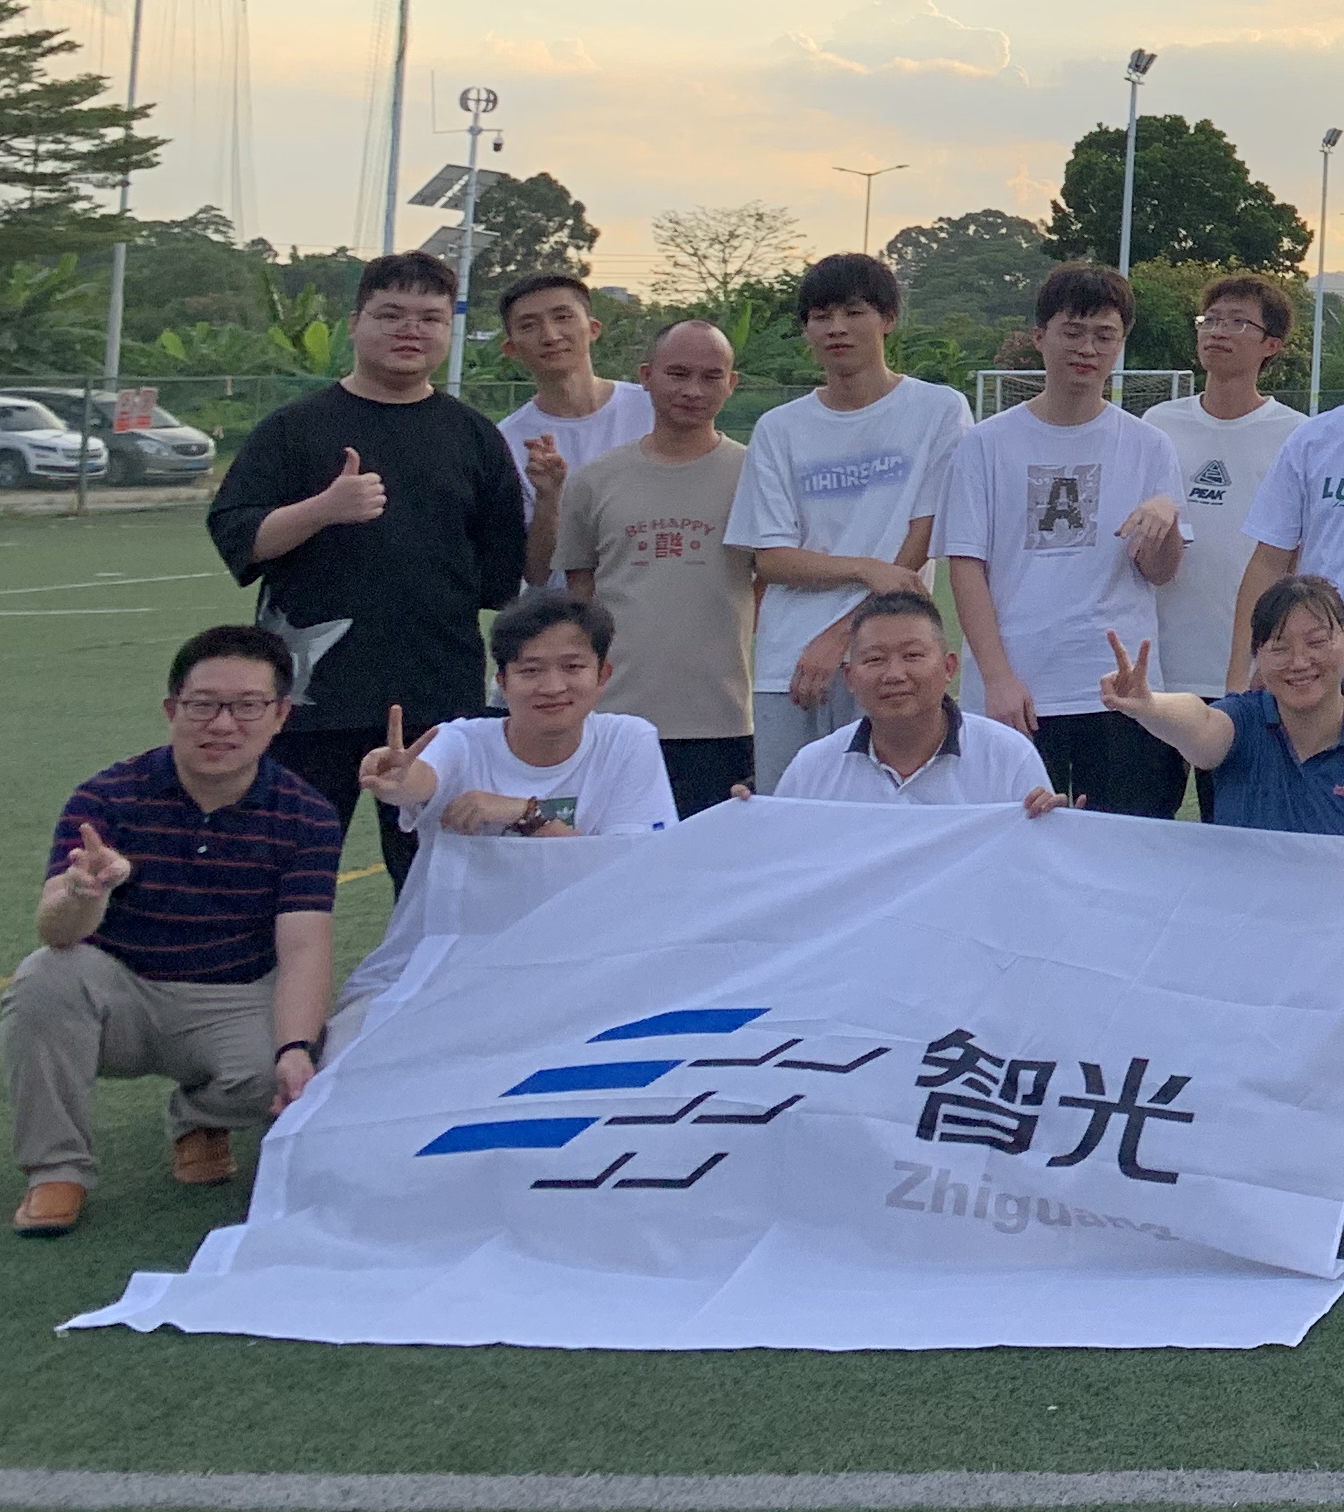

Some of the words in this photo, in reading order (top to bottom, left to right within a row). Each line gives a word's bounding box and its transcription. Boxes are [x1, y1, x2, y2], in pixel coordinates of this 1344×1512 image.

[1189, 487, 1227, 501] PEAK
[625, 521, 648, 538] BE
[651, 518, 716, 536] HAPPY
[914, 1028, 1195, 1185] 智光
